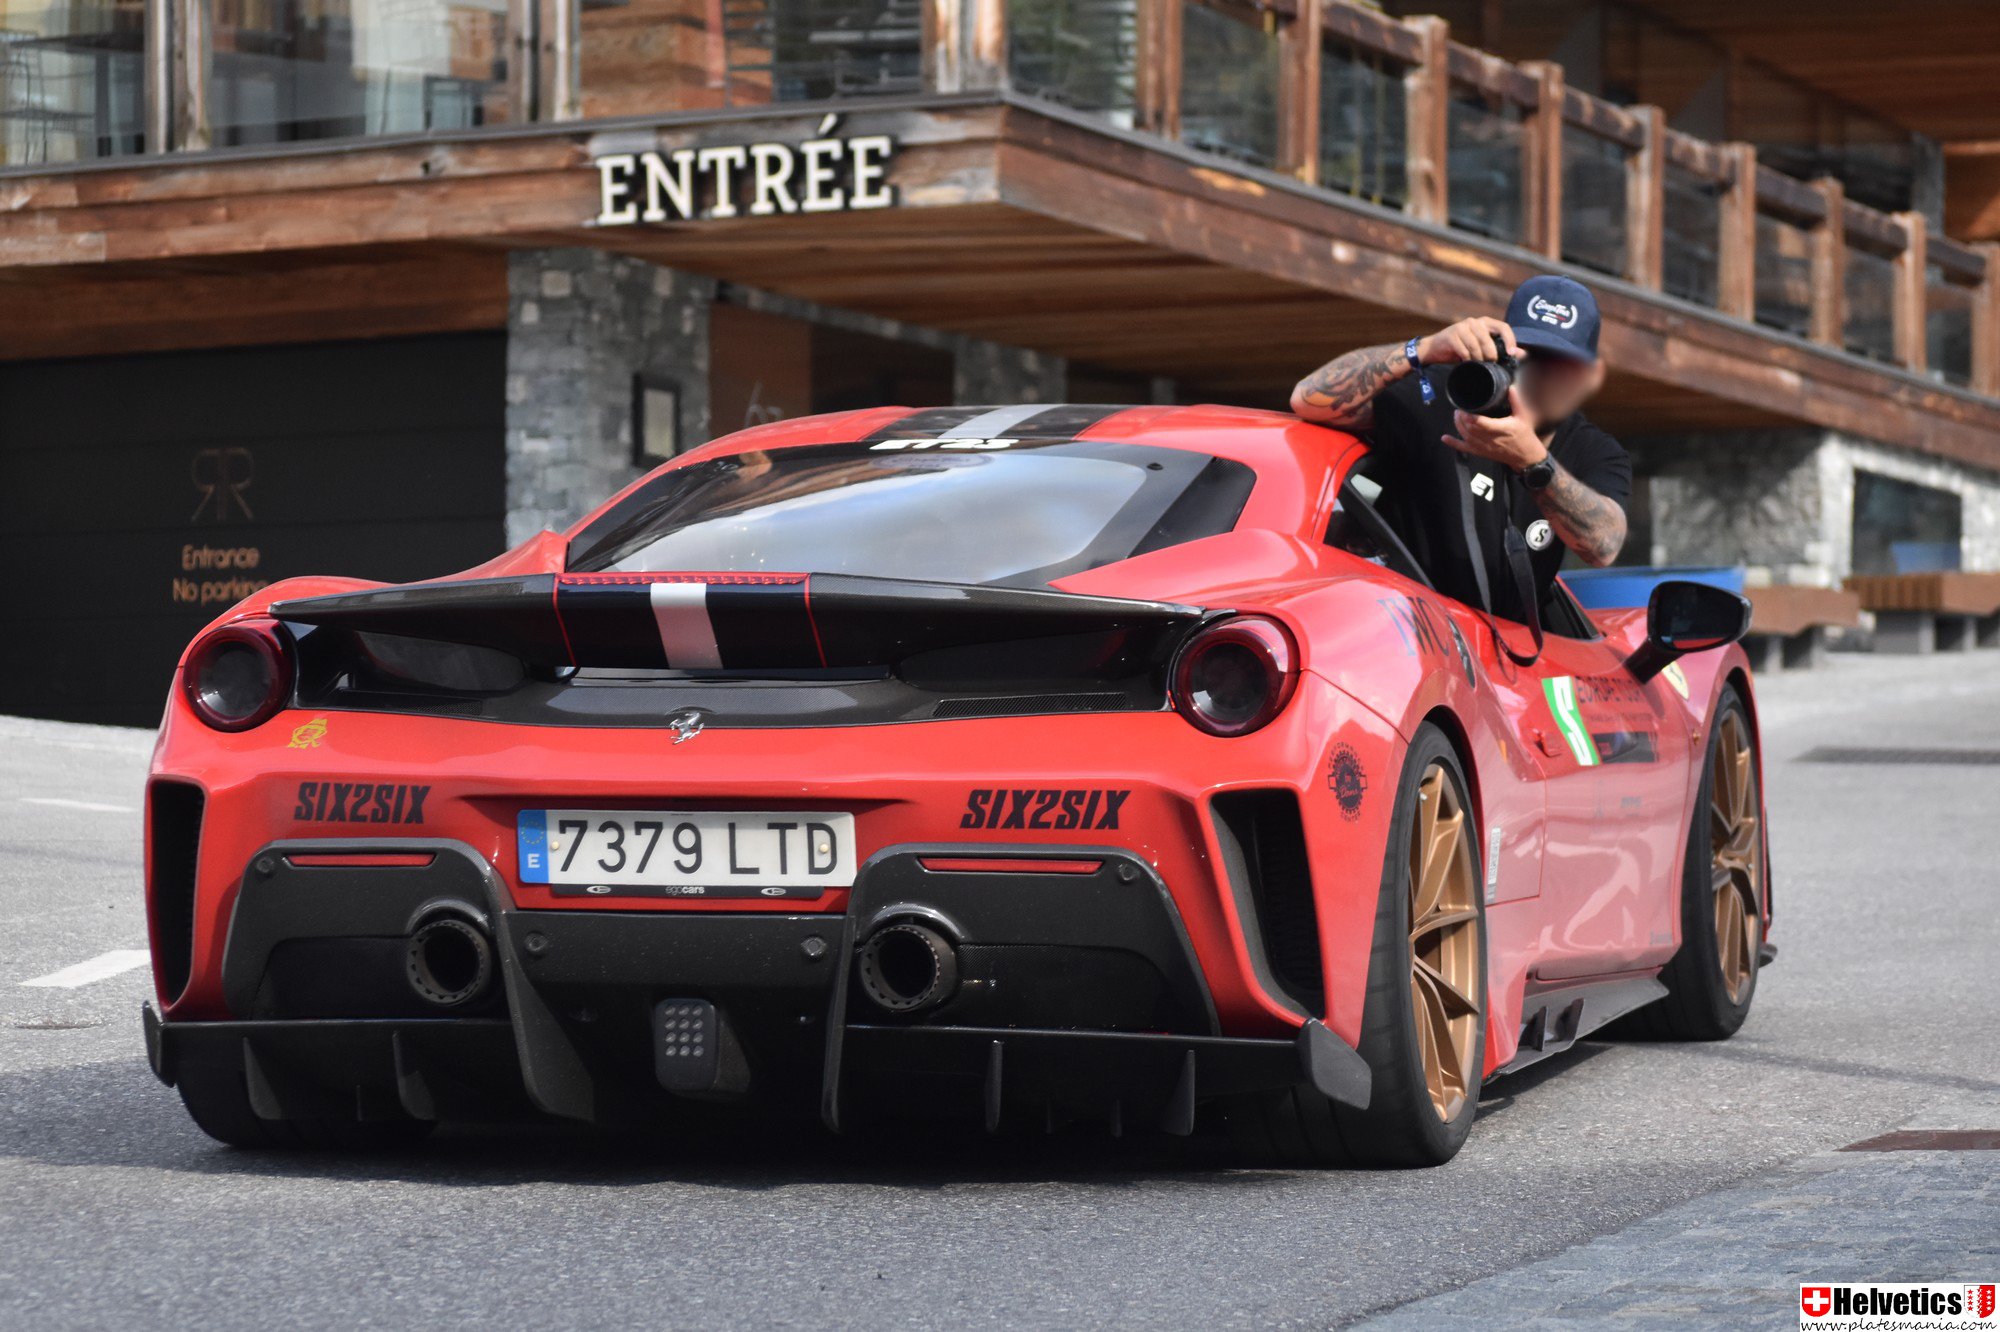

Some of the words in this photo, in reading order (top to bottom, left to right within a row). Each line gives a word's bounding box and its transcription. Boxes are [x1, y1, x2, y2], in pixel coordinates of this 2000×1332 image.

[596, 113, 892, 226] ENTRÉE
[182, 544, 260, 570] Entrance
[173, 574, 199, 602] No
[293, 781, 431, 824] SIX2SIX
[960, 789, 1131, 830] SIX2SIX
[527, 853, 540, 868] E
[559, 819, 703, 874] 7379
[728, 822, 838, 876] LTD
